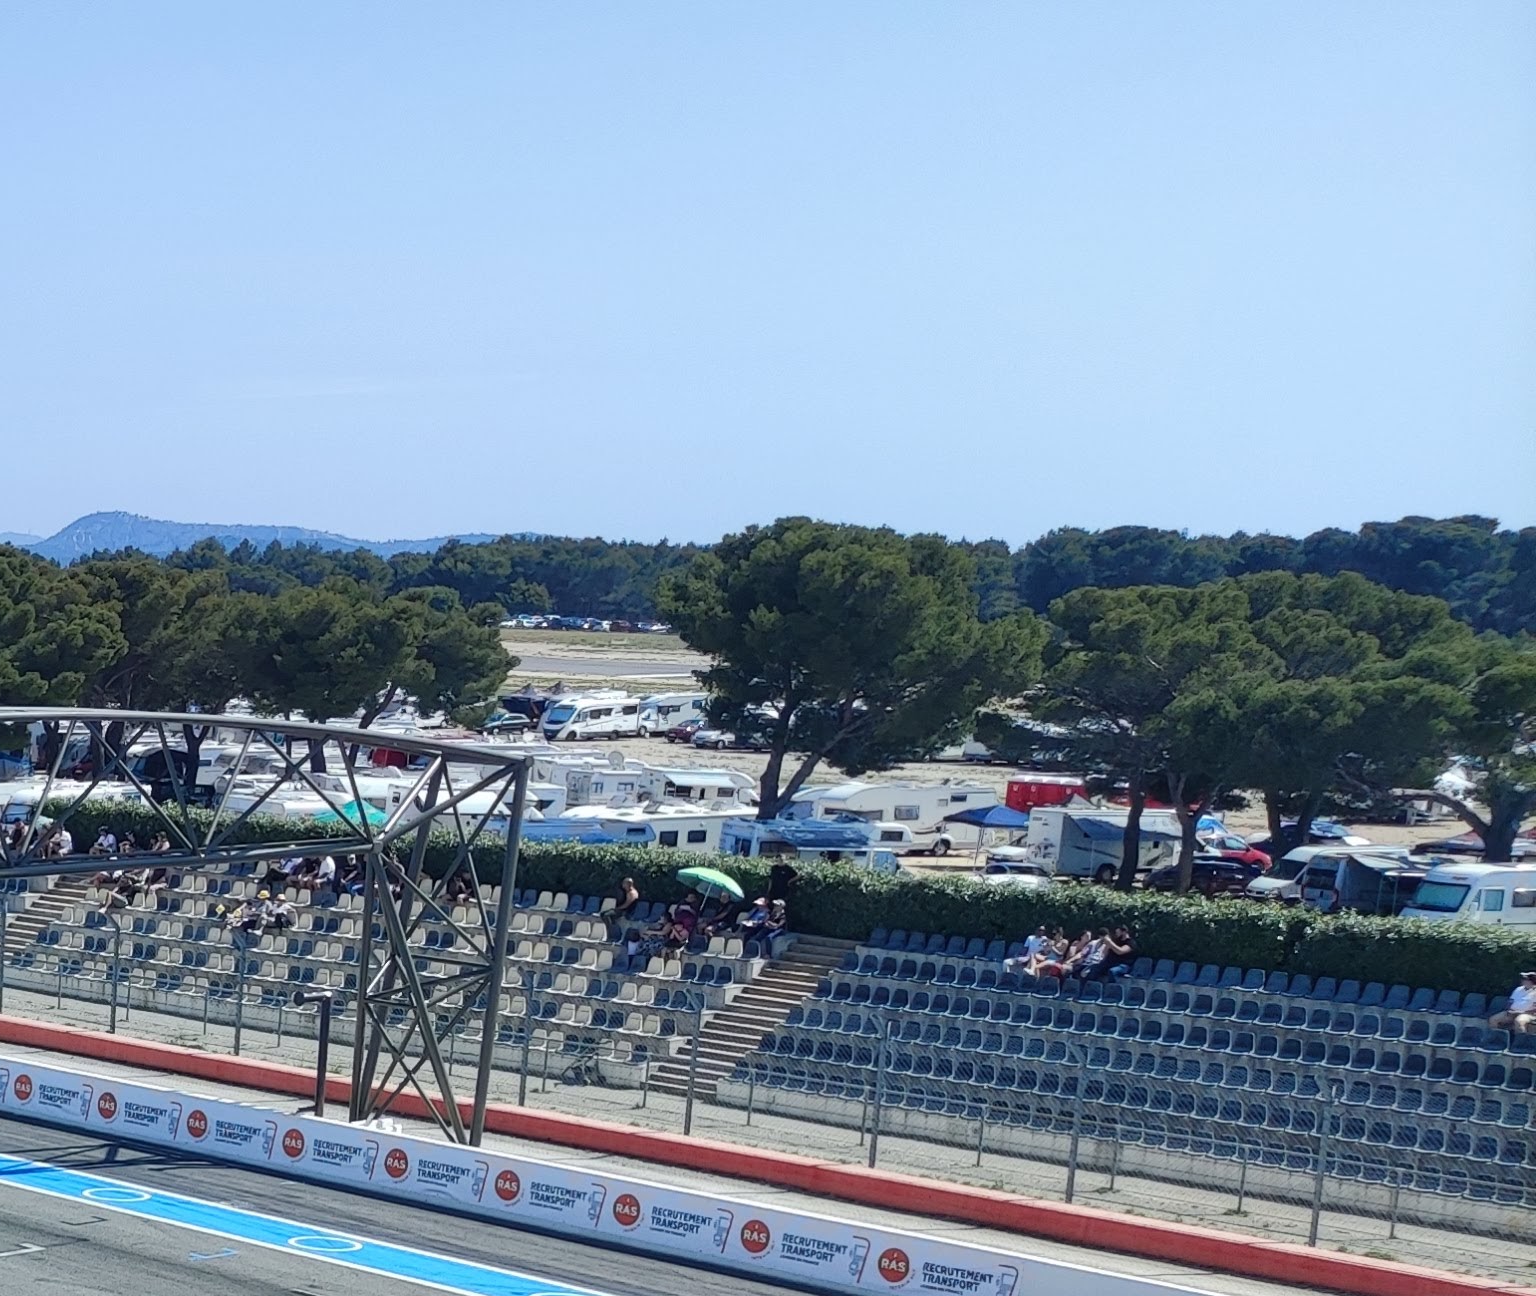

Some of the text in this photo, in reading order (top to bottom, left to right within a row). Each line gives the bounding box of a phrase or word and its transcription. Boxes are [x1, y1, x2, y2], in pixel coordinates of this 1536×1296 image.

[15, 1082, 31, 1093] RAS
[99, 1100, 116, 1111] RAS
[189, 1118, 208, 1130] RAS
[284, 1137, 303, 1149] RAS
[313, 1139, 362, 1157] RECRUTEMENT
[313, 1148, 353, 1164] TRANSPORT
[386, 1157, 408, 1170] RAS
[418, 1159, 471, 1178] RECRUTEMENT
[417, 1169, 460, 1185] TRANSPORT
[497, 1179, 520, 1192] RAS
[530, 1181, 588, 1201] RECRUTEMENT
[530, 1191, 576, 1209] TRANSPORT
[615, 1203, 639, 1217] RAS
[651, 1206, 713, 1227] RECRUTEMENT
[650, 1216, 701, 1234] TRANSPORT
[743, 1229, 768, 1244] RAS
[782, 1233, 849, 1255] RECRUTEMENT
[781, 1244, 835, 1263] TRANSPORT
[880, 1257, 907, 1273] RAS
[922, 1262, 994, 1284] RECRUTEMENT
[922, 1272, 981, 1292] TRANSPORT
